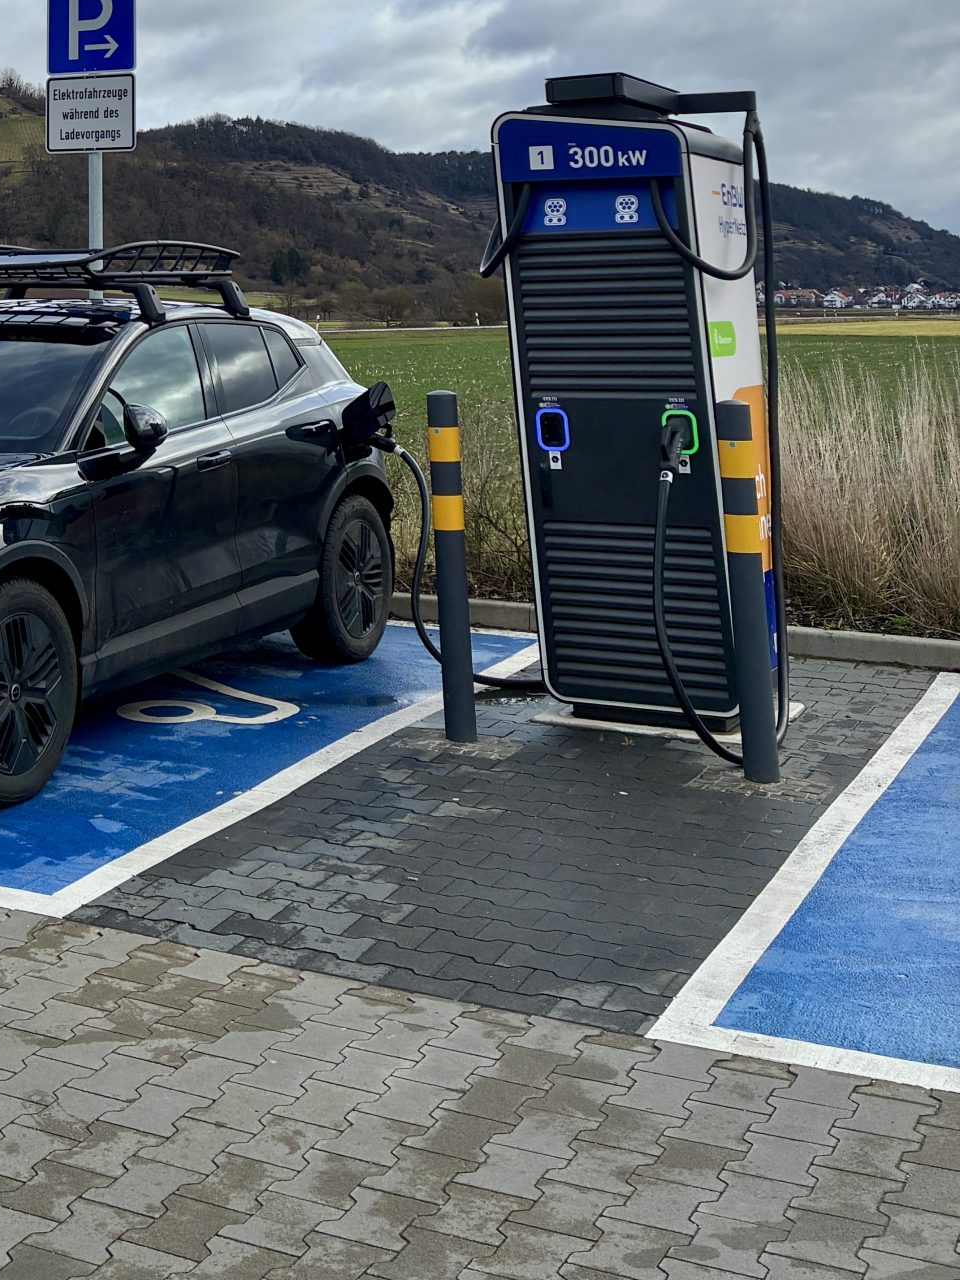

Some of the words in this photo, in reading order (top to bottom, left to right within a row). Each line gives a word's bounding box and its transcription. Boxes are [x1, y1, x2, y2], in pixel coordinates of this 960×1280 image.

[53, 87, 128, 101] Elektrofahrzeuge
[62, 107, 99, 120] während
[103, 107, 119, 119] des
[60, 128, 121, 142] Ladevorgangs
[537, 150, 544, 165] 1
[568, 145, 614, 168] 300
[618, 150, 647, 166] kW
[721, 183, 743, 208] EnBW
[719, 215, 746, 238] HyperNetz
